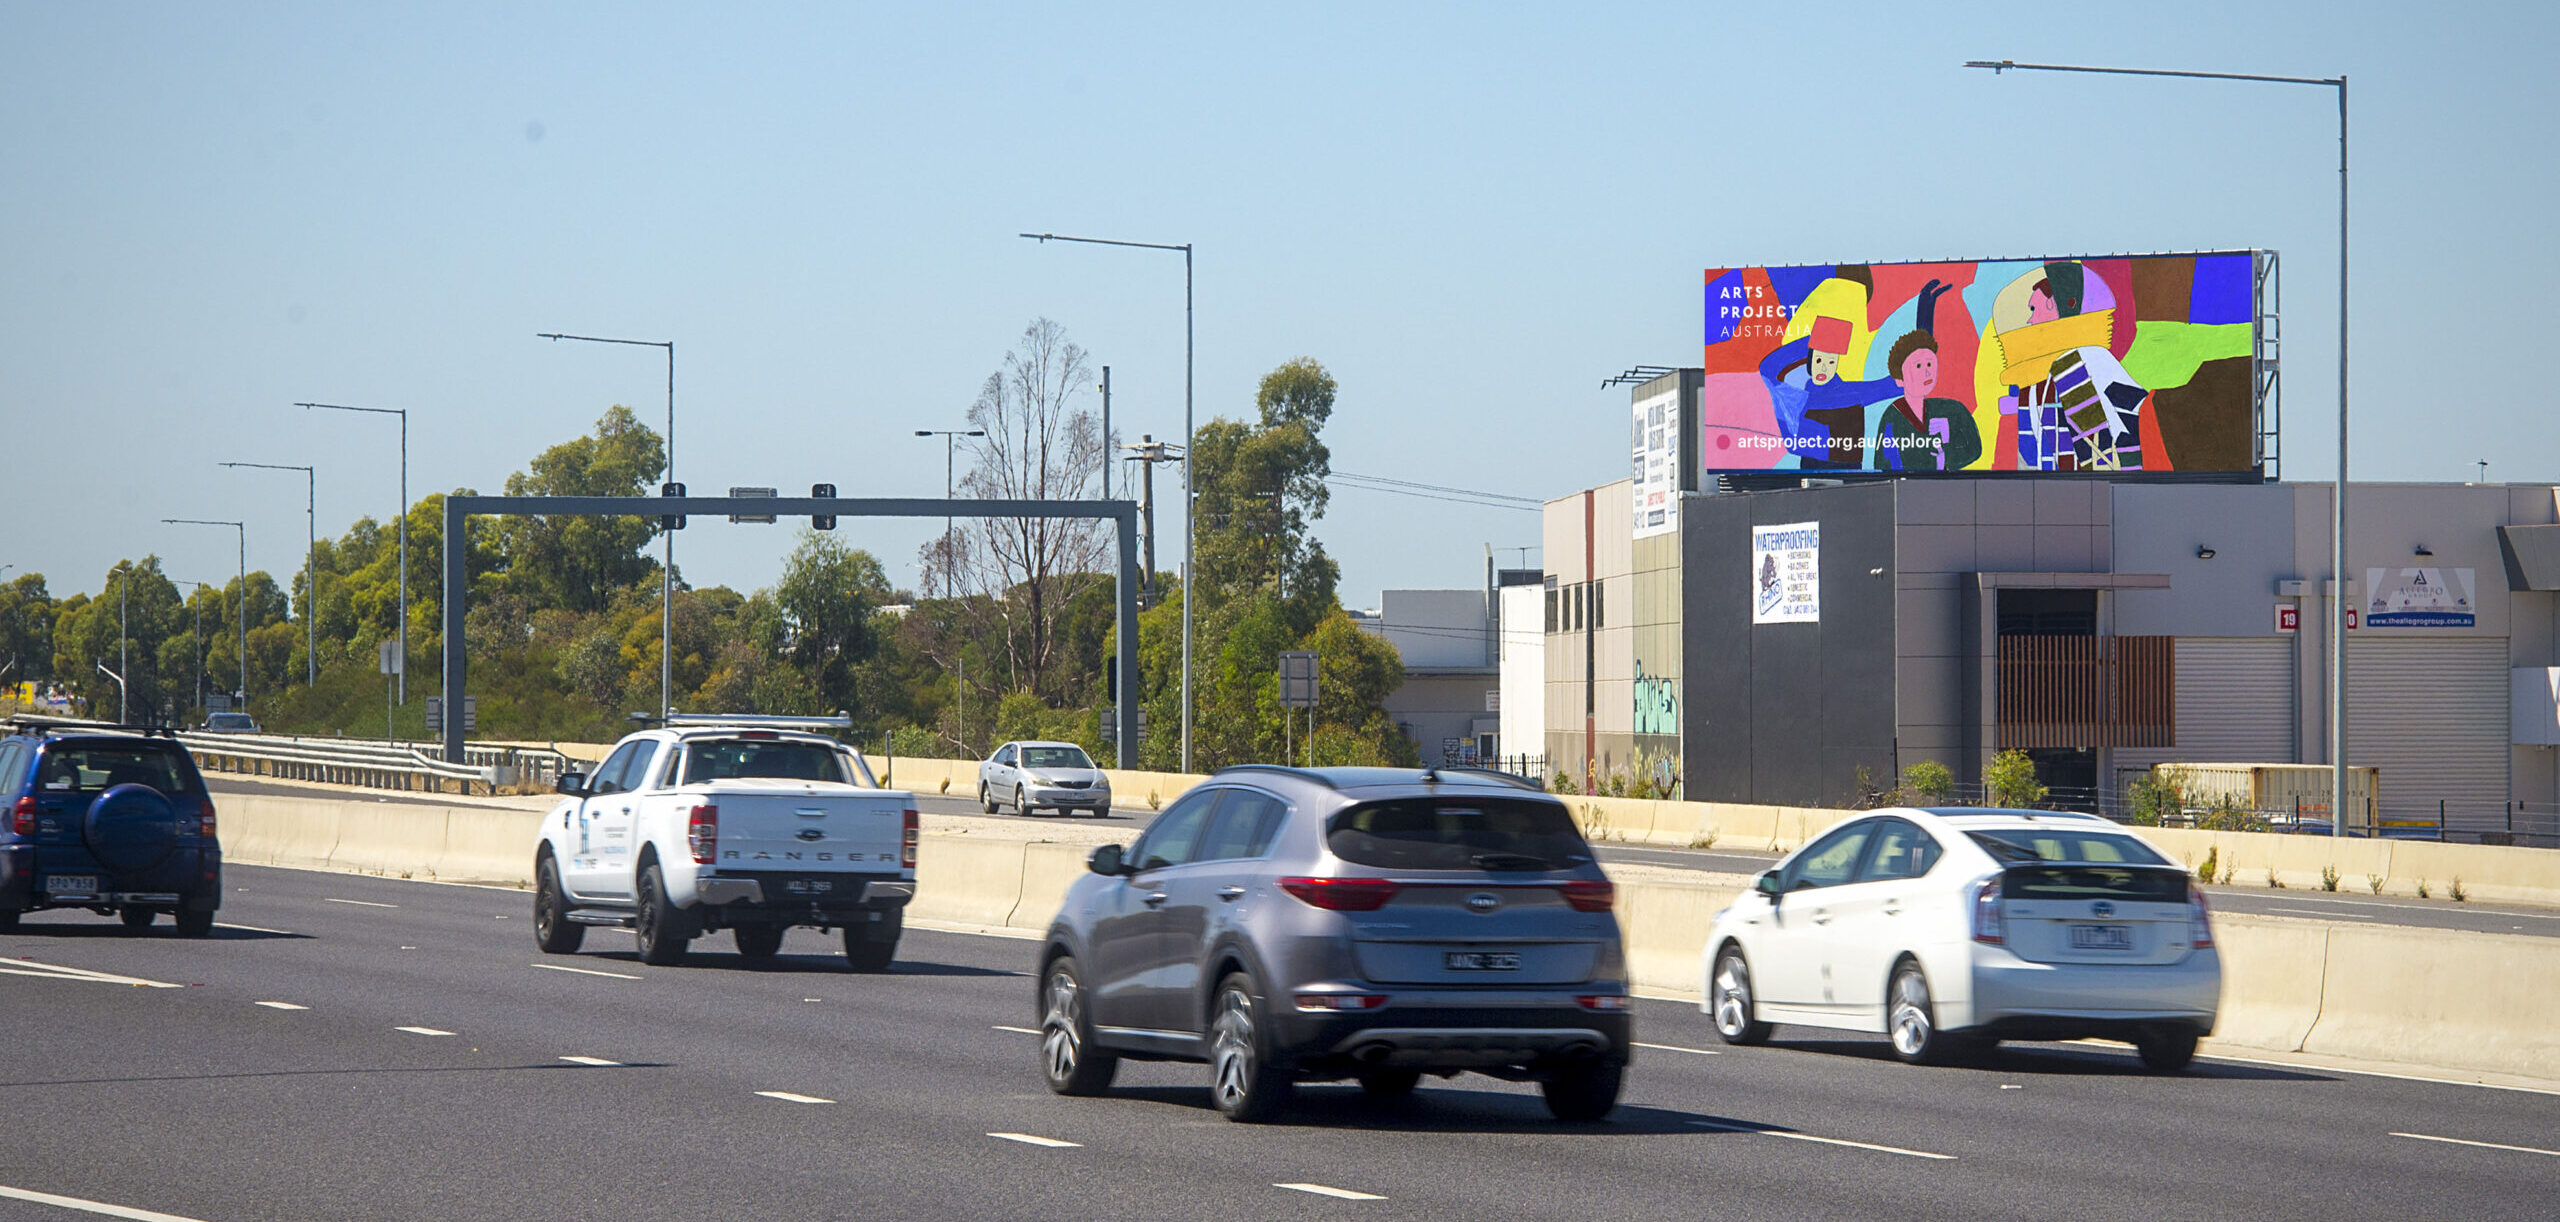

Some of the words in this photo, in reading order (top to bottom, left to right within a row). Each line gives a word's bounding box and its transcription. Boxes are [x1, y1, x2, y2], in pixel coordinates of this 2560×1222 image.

[1720, 286, 1763, 299] ARTS
[1720, 305, 1798, 318] PROJECT
[1720, 325, 1812, 338] AUSTRALIA
[1738, 433, 1942, 451] artsproject.org.au/explore
[1755, 530, 1818, 551] WATERPROOFING
[2283, 613, 2296, 626] 19
[723, 850, 896, 862] RANGER
